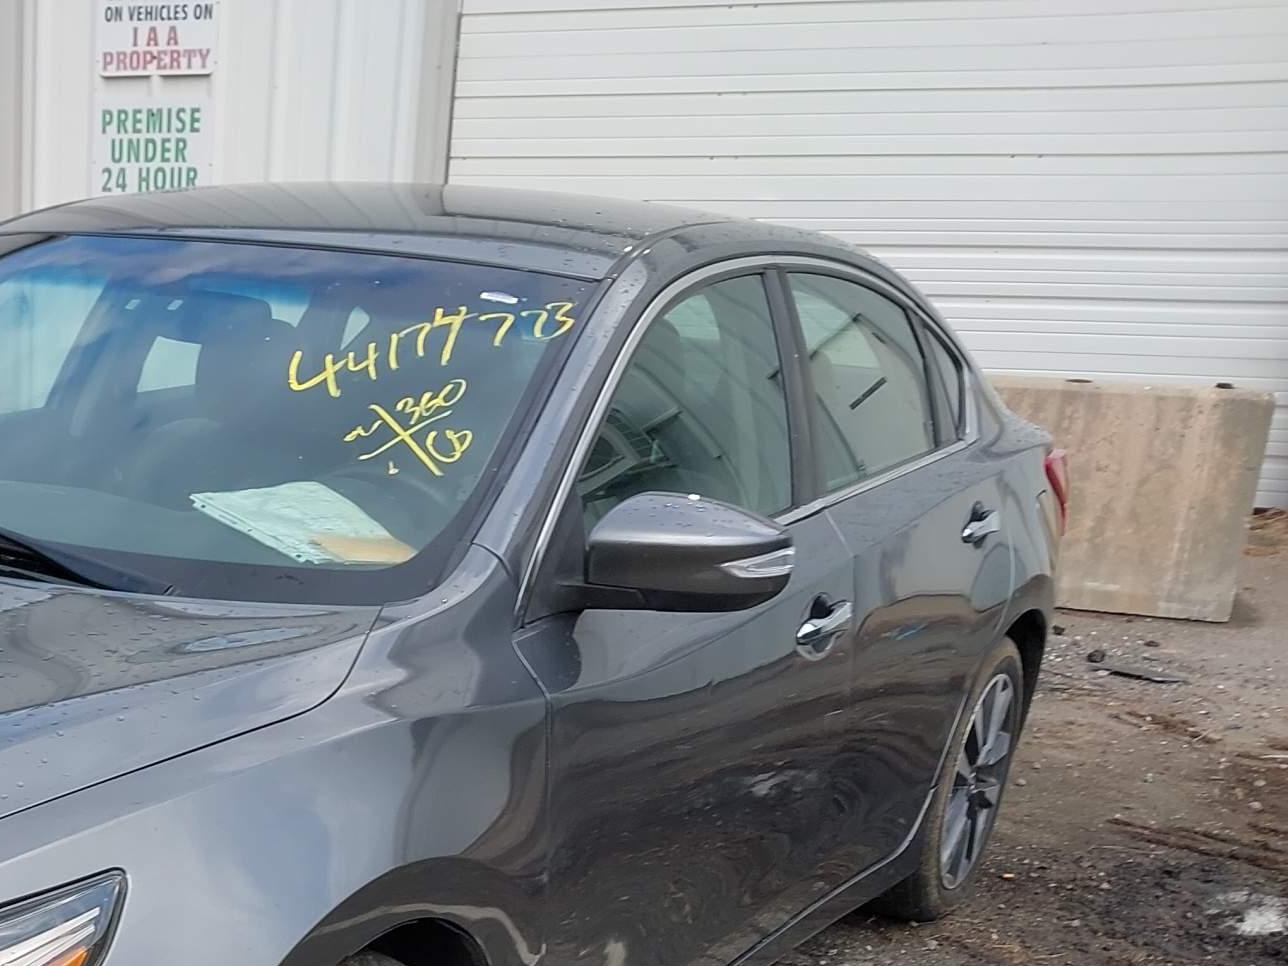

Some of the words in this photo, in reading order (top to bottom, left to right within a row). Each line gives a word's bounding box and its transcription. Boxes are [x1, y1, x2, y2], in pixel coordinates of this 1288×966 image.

[105, 6, 123, 22] ON
[128, 4, 188, 21] VEHICLES
[193, 3, 214, 20] ON
[102, 48, 211, 71] PROPERTY
[101, 107, 201, 134] PREMISE
[111, 137, 188, 163] UNDER
[101, 167, 127, 193] 24
[138, 166, 198, 193] HOUR
